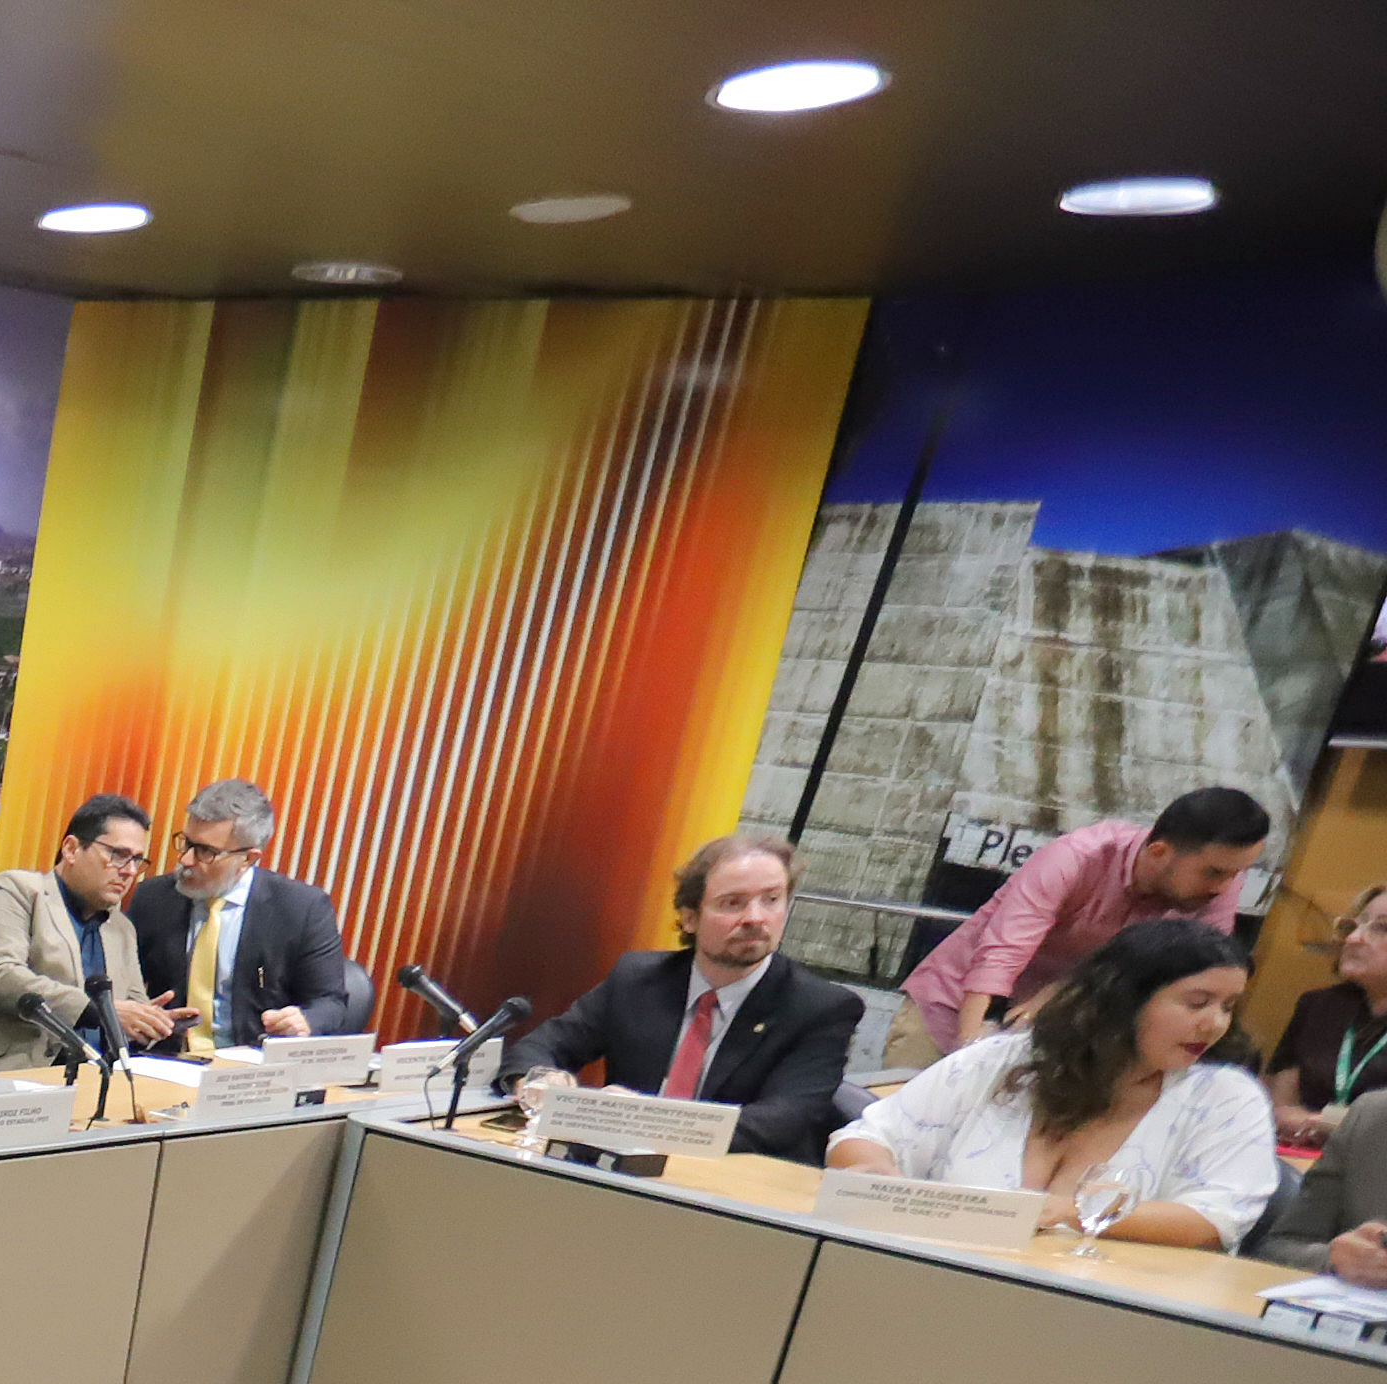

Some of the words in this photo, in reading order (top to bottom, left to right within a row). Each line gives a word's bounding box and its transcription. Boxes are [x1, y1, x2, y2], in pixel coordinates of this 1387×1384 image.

[976, 824, 1033, 868] Ple
[19, 1107, 42, 1117] FILHO
[556, 1094, 597, 1107] VICTOR
[643, 1105, 725, 1122] MONTENEGRO
